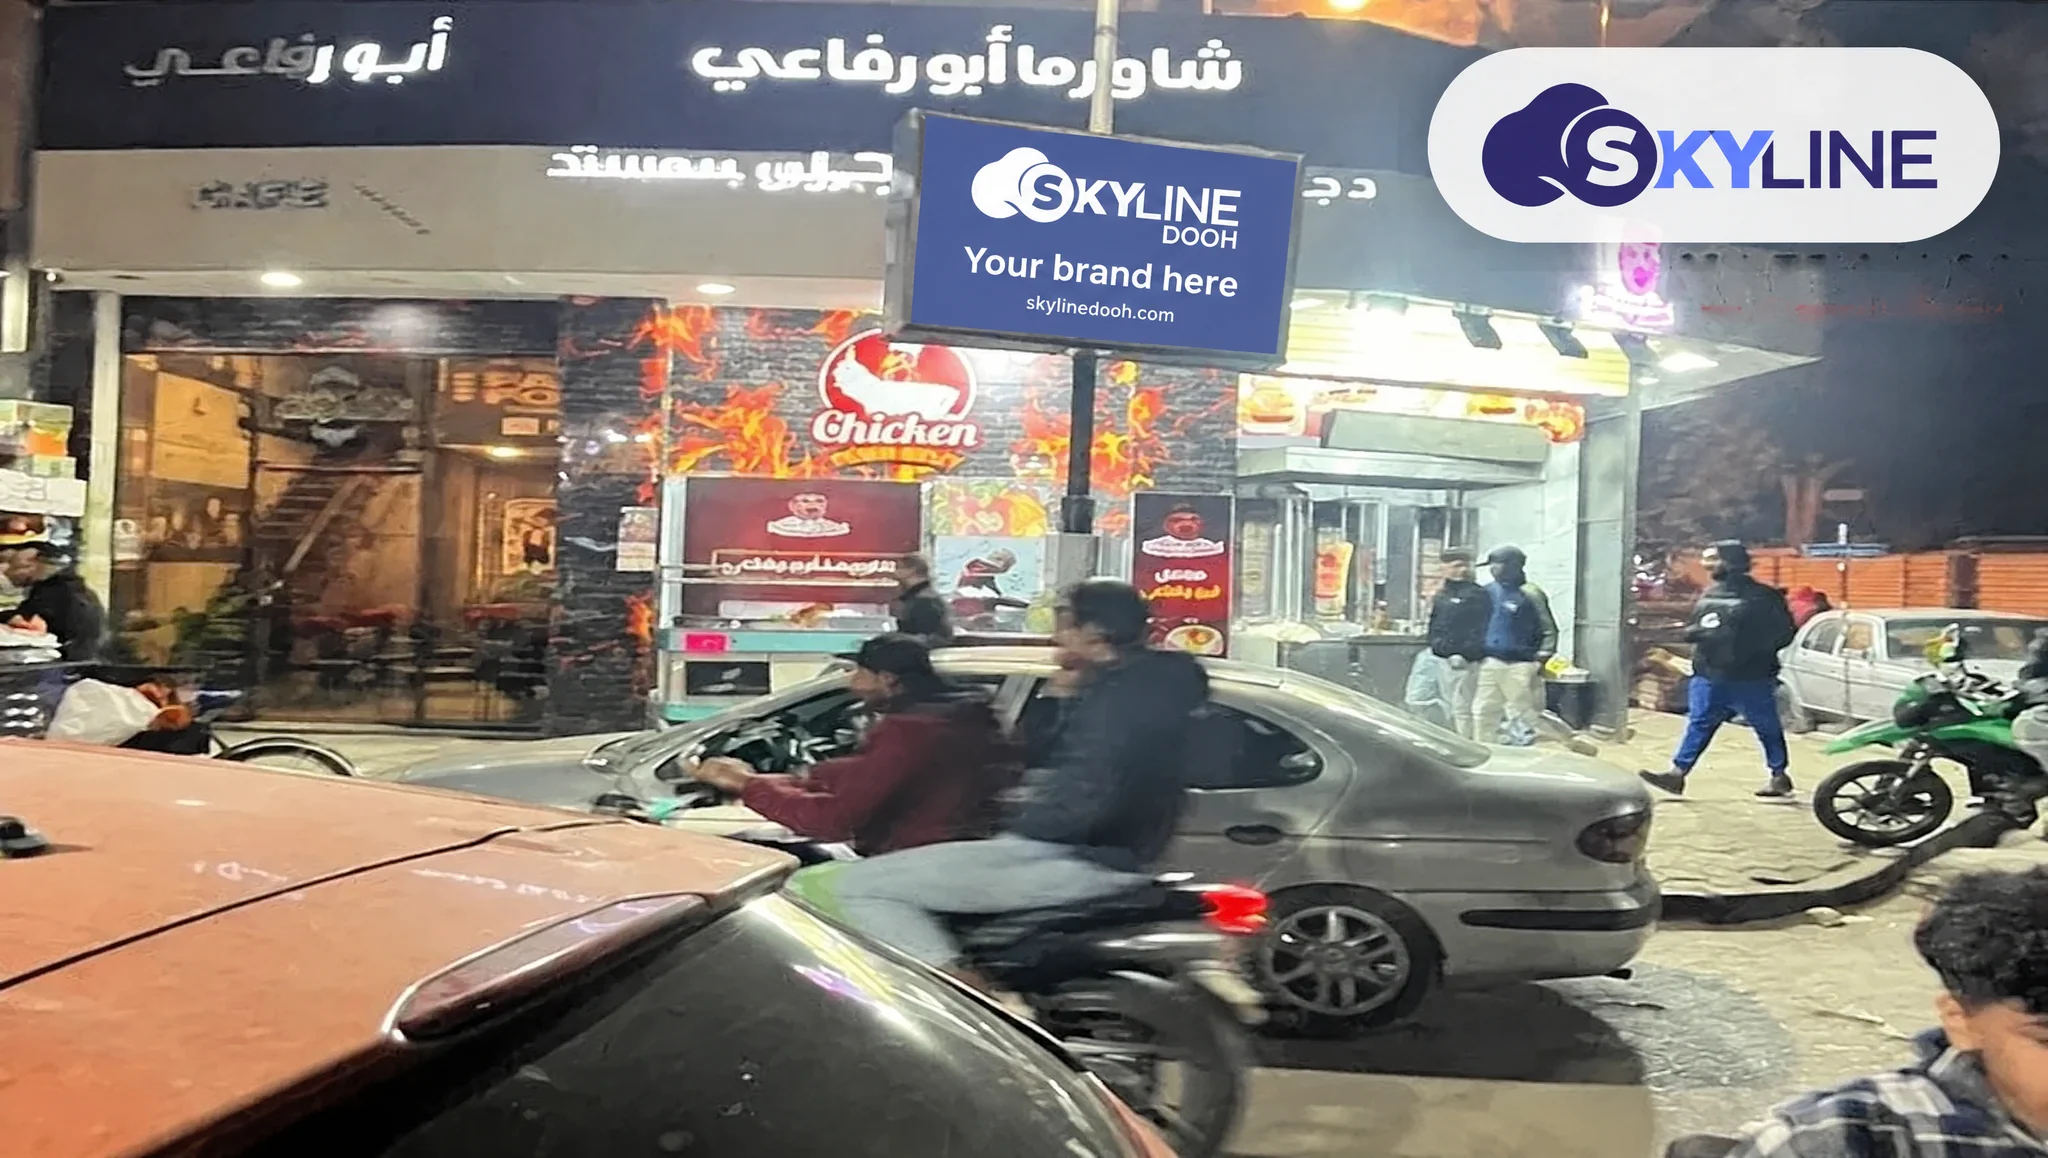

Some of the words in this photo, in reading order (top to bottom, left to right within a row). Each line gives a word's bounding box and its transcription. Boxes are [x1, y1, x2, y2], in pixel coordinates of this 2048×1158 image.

[123, 33, 335, 87] رفاعي
[343, 16, 454, 84] أبو
[691, 33, 918, 94] رفاعي
[926, 24, 1013, 96] أبو
[1016, 38, 1243, 100] شاورما
[1031, 173, 1242, 227] SKYLINE
[1162, 225, 1238, 249] DOOH
[964, 246, 1044, 279] Your
[1053, 254, 1153, 290] brand
[1162, 265, 1239, 298] here
[1026, 296, 1175, 322] skylinedooh.com
[811, 408, 979, 447] Chicken
